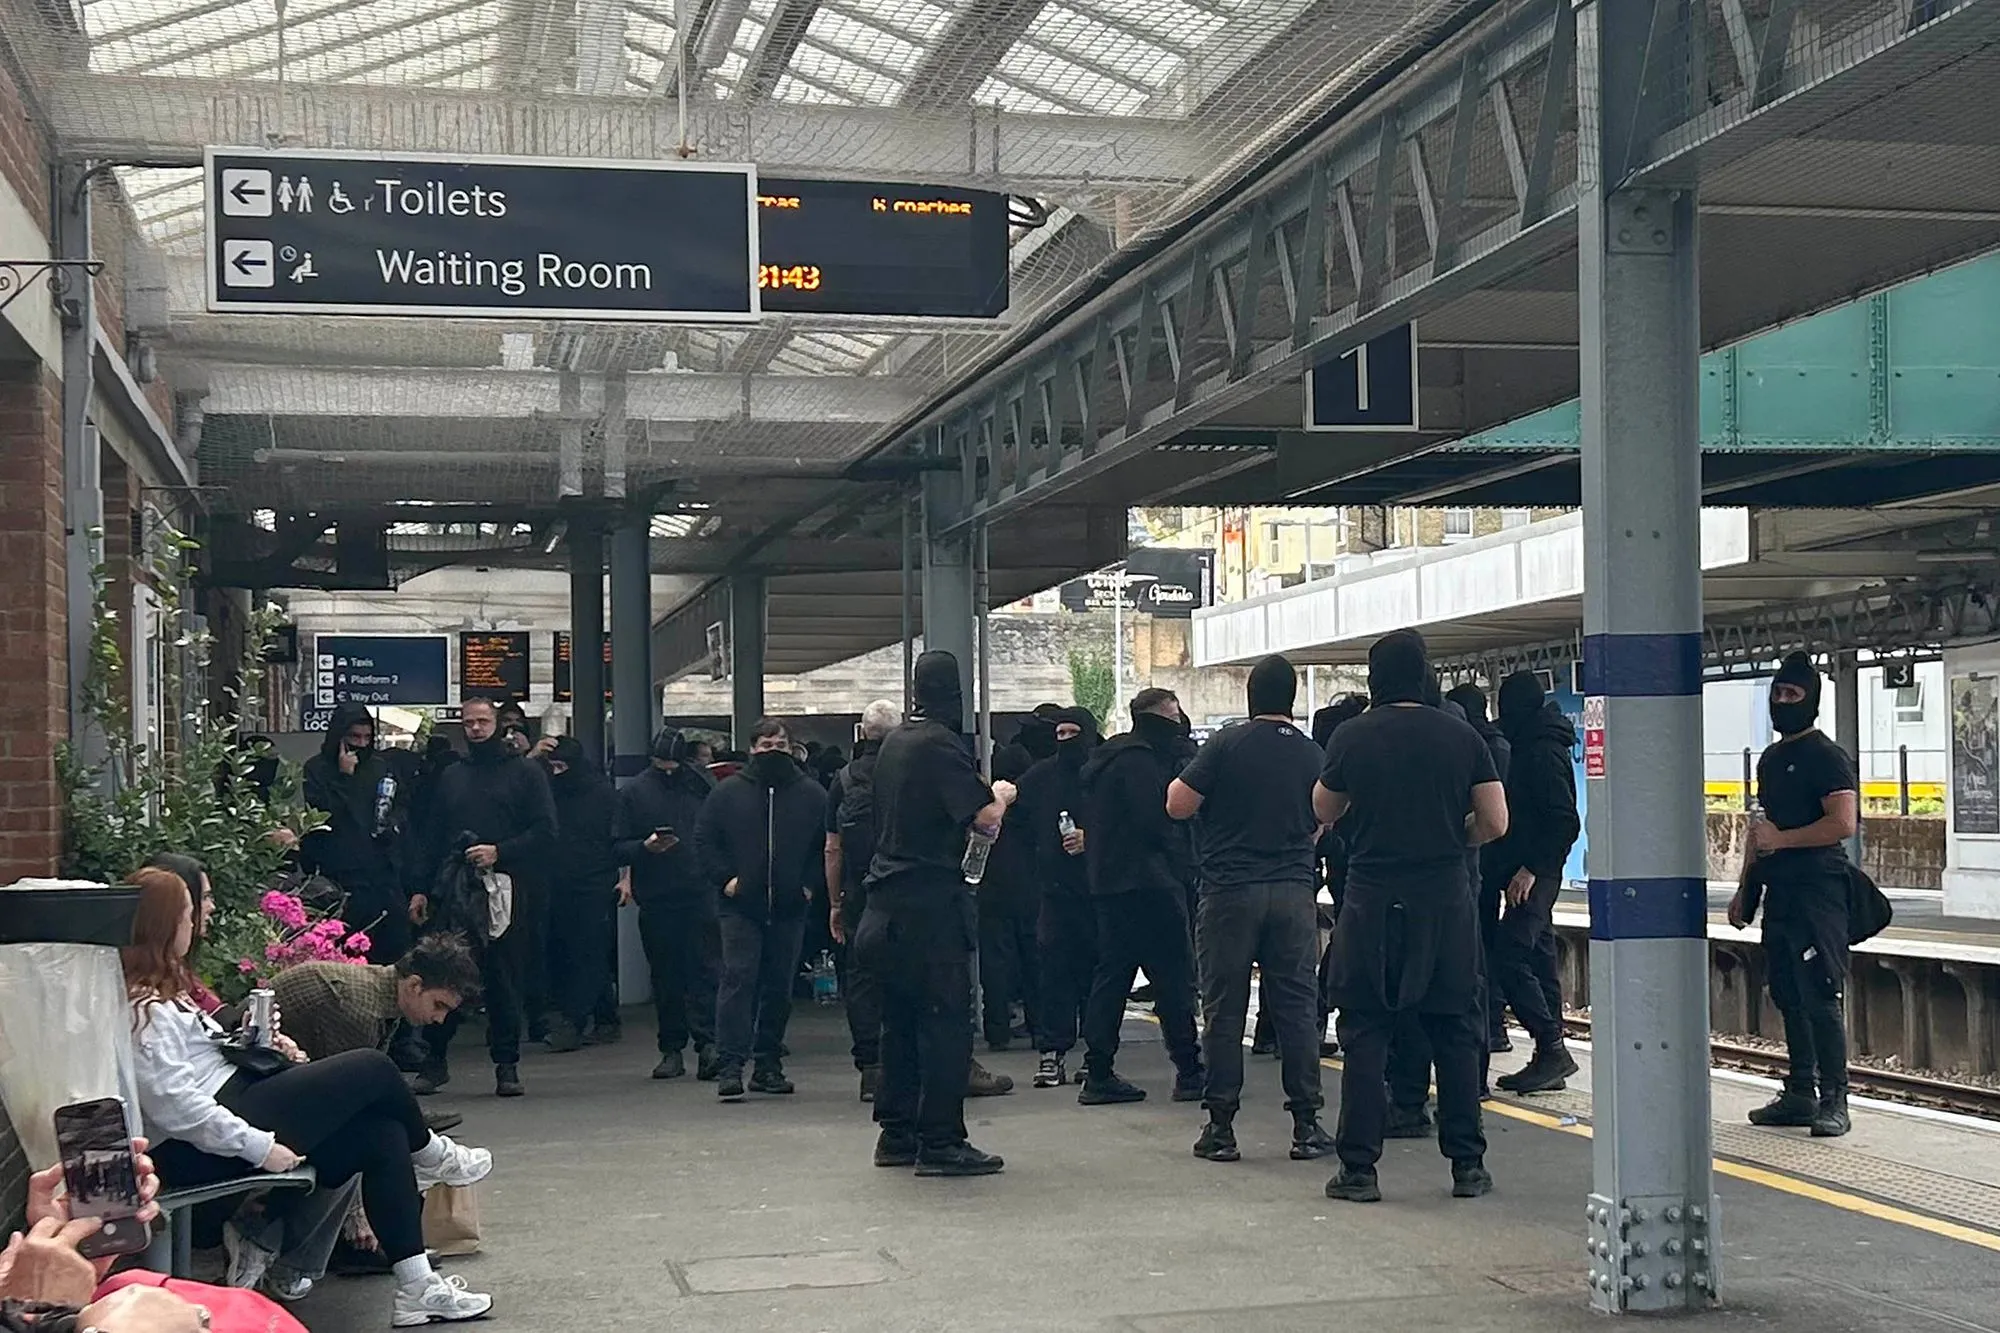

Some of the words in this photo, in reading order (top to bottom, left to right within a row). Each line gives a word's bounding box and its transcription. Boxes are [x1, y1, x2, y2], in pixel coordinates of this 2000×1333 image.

[375, 179, 507, 218] Toilets
[376, 248, 527, 296] Waiting
[538, 253, 652, 290] Room
[1340, 342, 1369, 410] 1
[351, 658, 374, 668] Taxis
[351, 674, 391, 685] Platform
[392, 674, 399, 685] 2
[1893, 665, 1908, 685] 3
[350, 692, 370, 702] Way
[371, 691, 390, 702] Out
